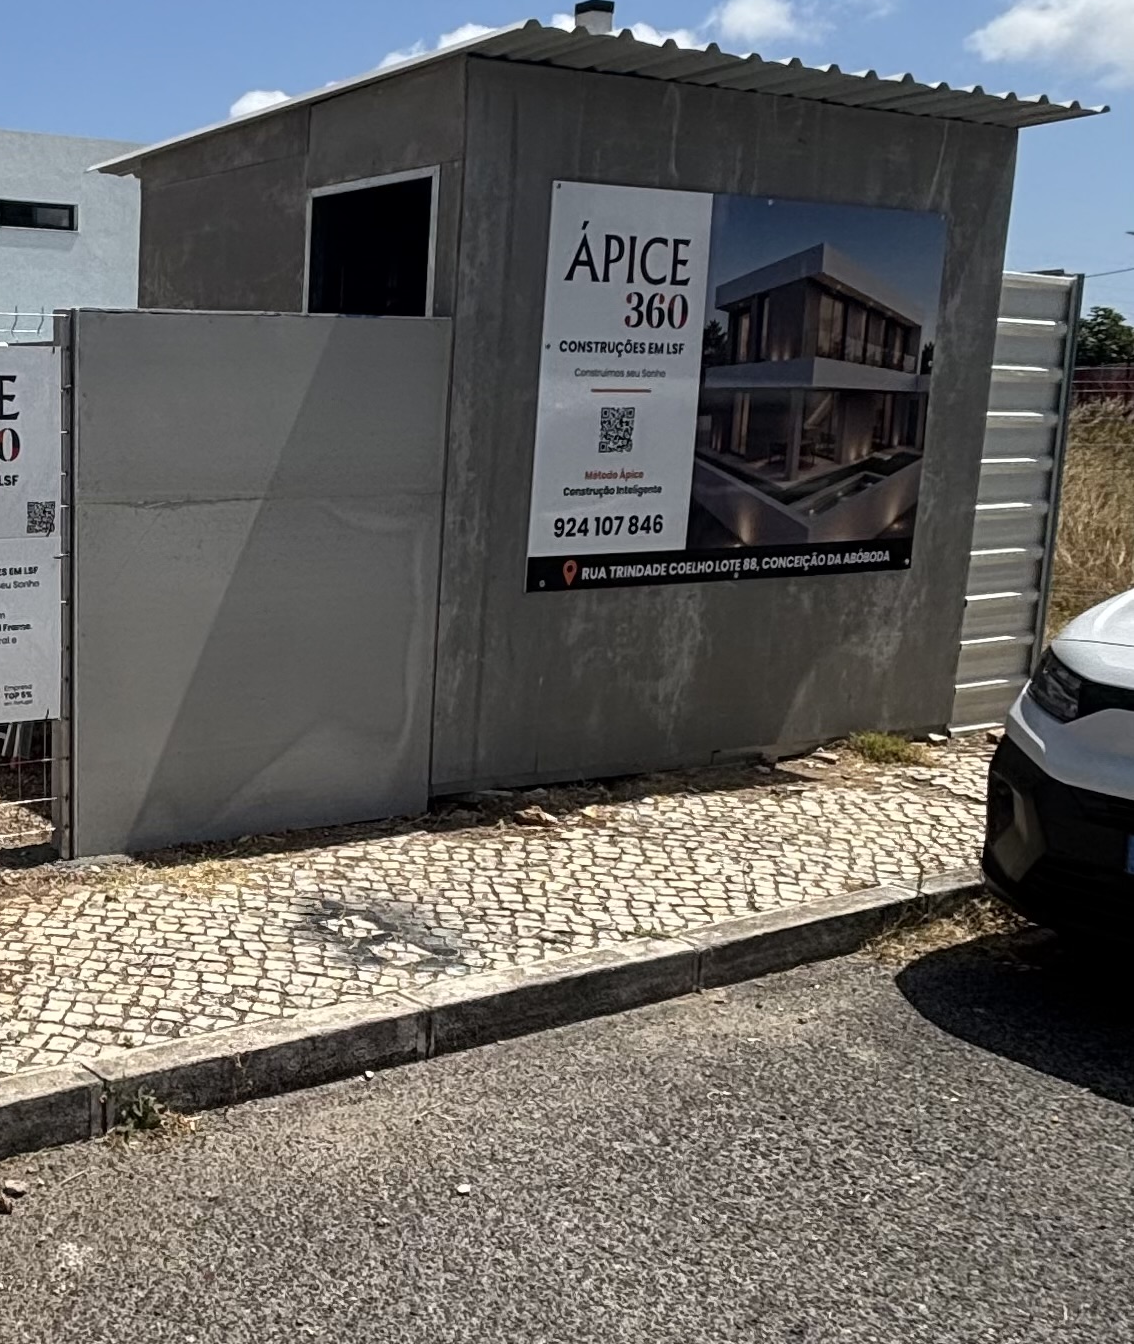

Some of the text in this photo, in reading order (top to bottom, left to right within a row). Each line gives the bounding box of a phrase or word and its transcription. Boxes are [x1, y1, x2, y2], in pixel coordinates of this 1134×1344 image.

[563, 220, 692, 287] ÁPICE
[624, 291, 689, 330] 360
[559, 339, 685, 358] CONSTRUÇÕES EM LSF
[626, 370, 641, 378] seu
[641, 368, 666, 378] Sonho
[585, 468, 644, 482] Método Ápice
[563, 485, 662, 498] Construção Inteligente
[553, 514, 664, 538] 924 107 846
[9, 567, 23, 576] EM
[23, 566, 39, 575] LSF
[581, 567, 607, 580] RUA
[609, 563, 667, 578] TRINDADE
[669, 560, 714, 576] COELHO
[716, 558, 741, 573] LOTE
[742, 558, 760, 572] 88,
[762, 552, 825, 572] CONCEIÇÃO
[827, 553, 842, 565] DA
[12, 579, 40, 589] Sonho
[10, 637, 17, 645] e
[3, 692, 20, 700] TOP
